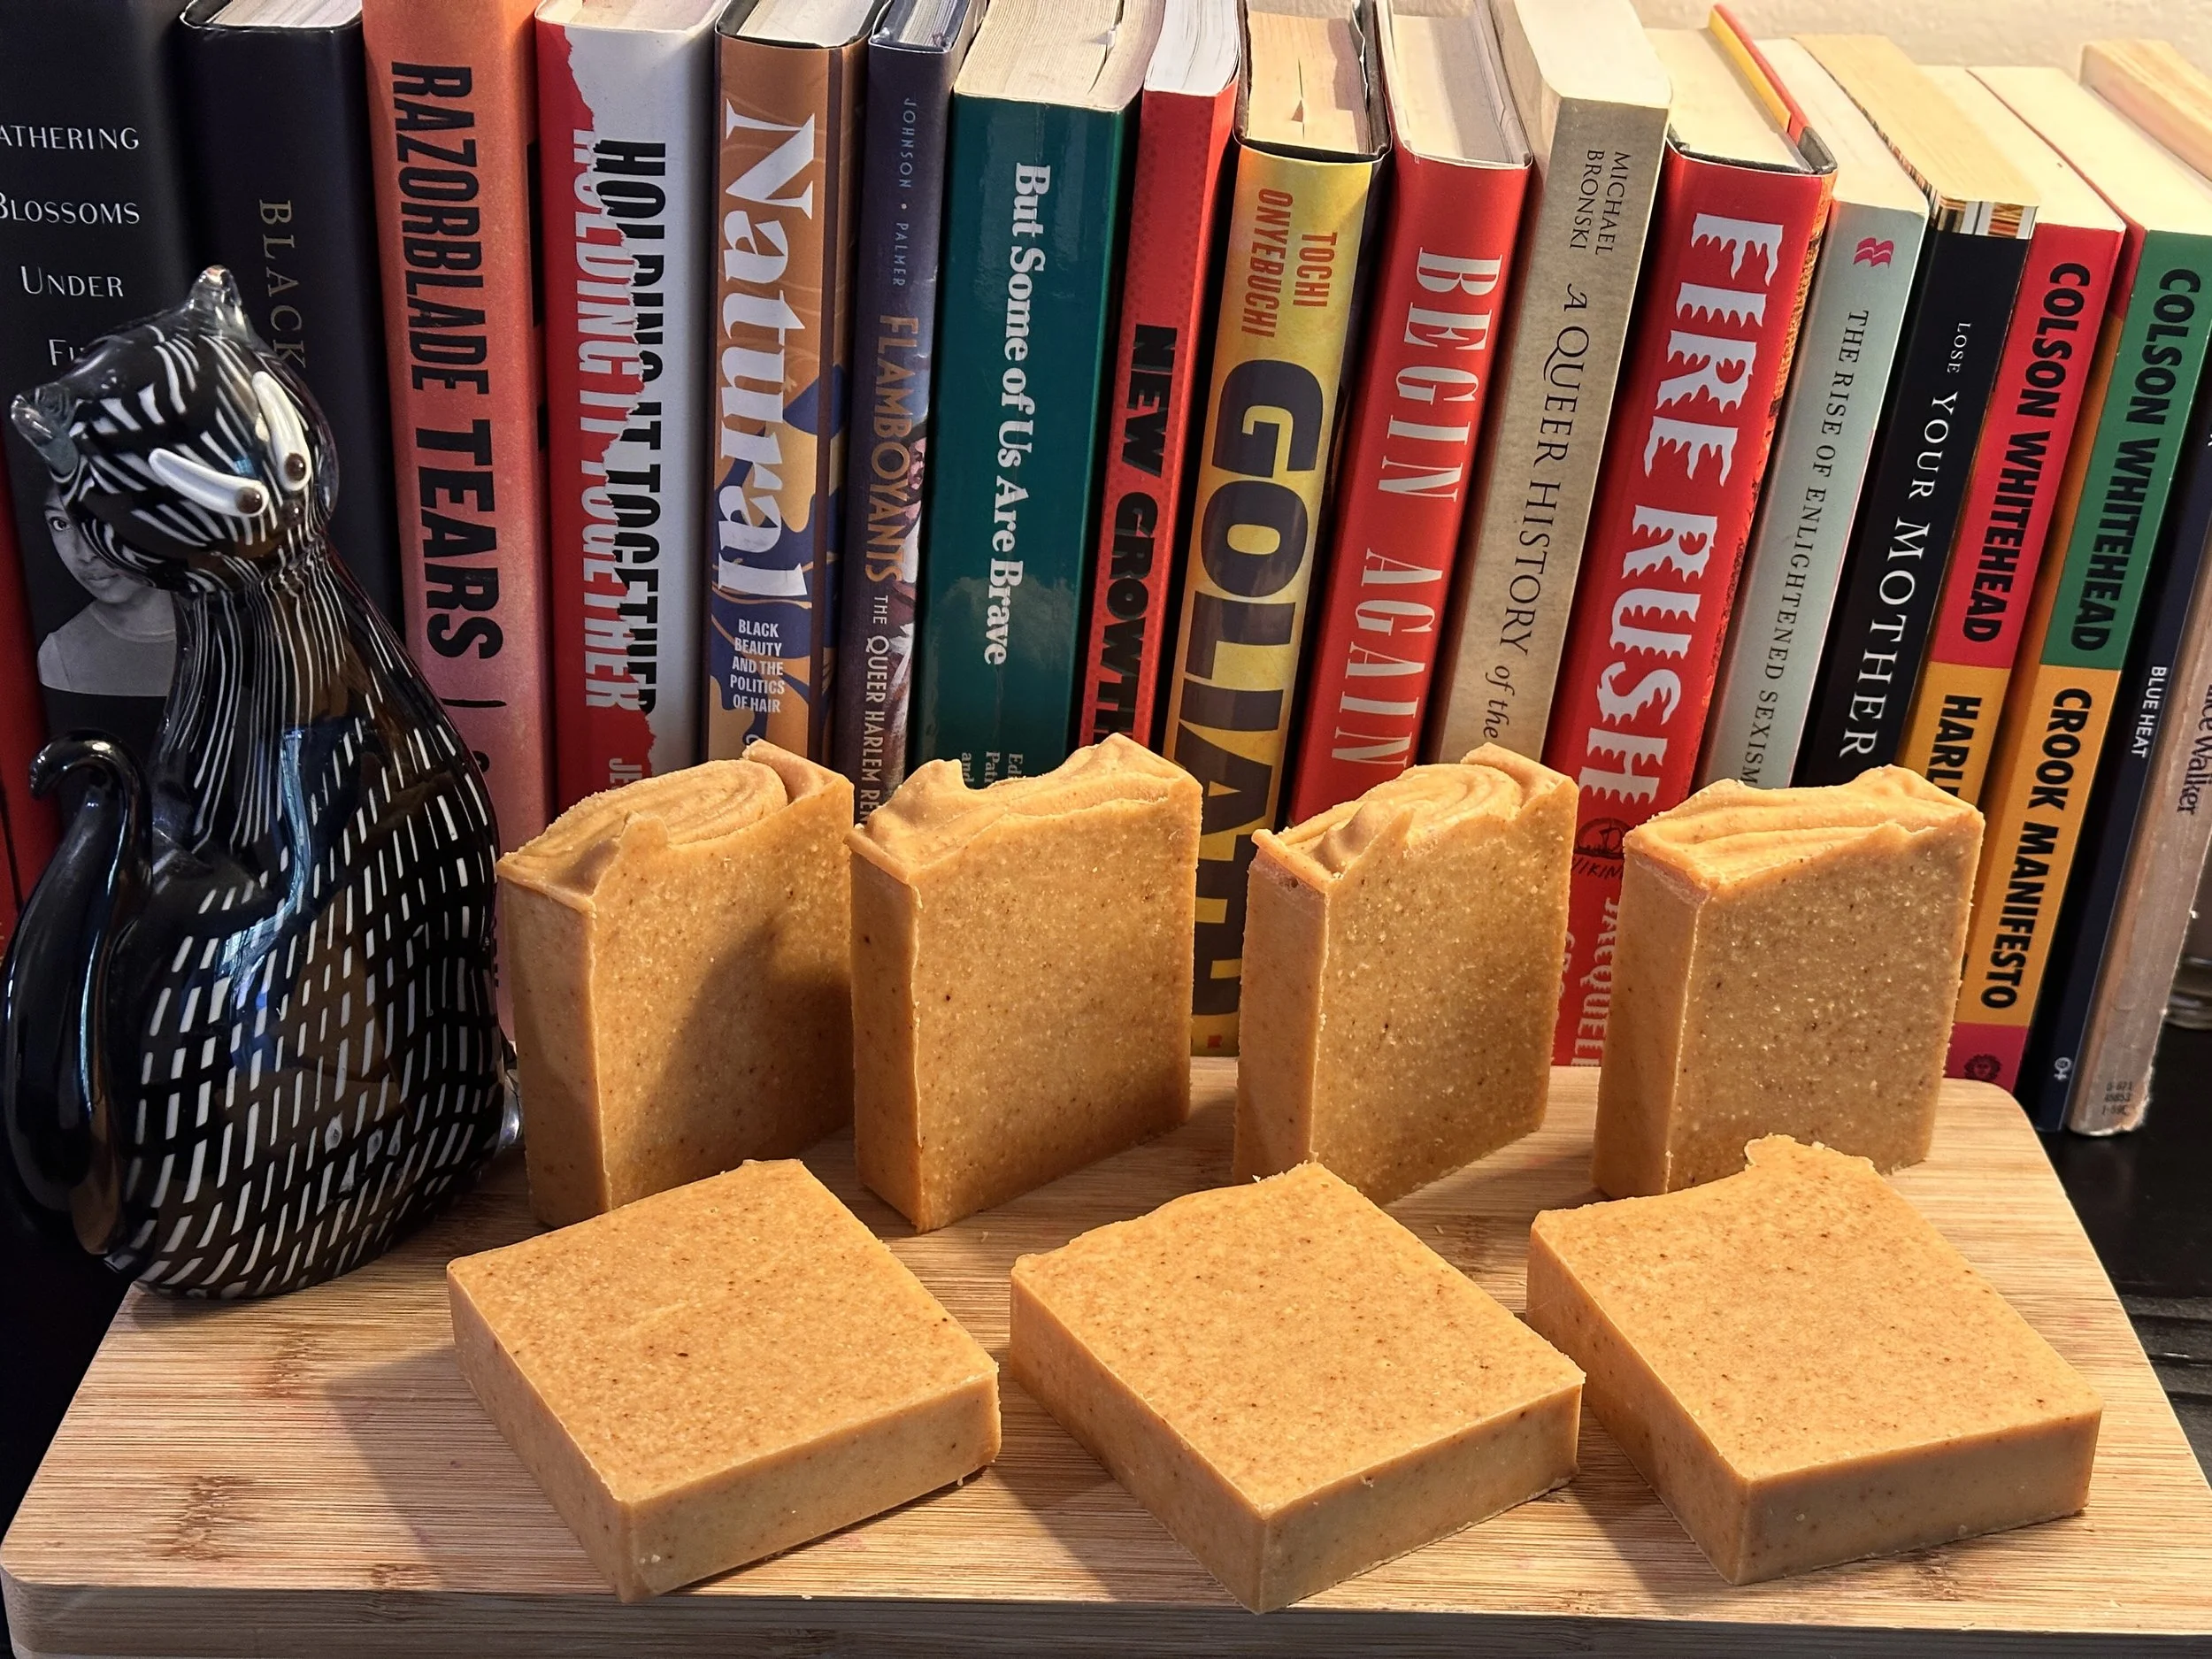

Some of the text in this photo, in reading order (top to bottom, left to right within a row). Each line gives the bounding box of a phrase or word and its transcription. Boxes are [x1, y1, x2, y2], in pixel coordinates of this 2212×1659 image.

[891, 97, 918, 287] JOHNSON PALMER
[1241, 188, 1294, 338] ONYEBUCHI
[1570, 150, 1605, 250] BRONSKI
[1594, 151, 1632, 256] MICHAEL
[20, 265, 124, 297] UNDER
[259, 200, 306, 368] BLACK
[1293, 232, 1338, 308] TOCHI
[390, 61, 503, 659] RAZORBLADE TEARS
[718, 98, 815, 596] Natural
[984, 162, 1051, 665] But Some of Us Are Brave
[1122, 324, 1178, 478] NEW
[865, 315, 919, 582] FLAMBOYANTS
[1332, 247, 1503, 768] BEGIN AGAIN
[1483, 283, 1590, 738] A QUEER HISTORY of the
[1578, 213, 1783, 804] FIRE RUSH
[1962, 262, 2091, 644] COLSON WHITEHEAD
[2070, 268, 2201, 651] COLSON WHITEHEAD
[872, 595, 889, 625] THE
[1740, 310, 1870, 786] THE RISE OF ENLIGHTENED SEXISM
[1839, 322, 1972, 759] LOSE YOUR MOTHER
[730, 674, 786, 695] POLITICS
[732, 656, 784, 676] AND THE
[733, 694, 781, 714] OF HAIR
[734, 636, 783, 657] BEAUTY
[738, 618, 780, 638] BLACK
[865, 635, 890, 703] QUEER
[862, 710, 885, 782] HARLEM
[1924, 695, 1983, 797] HARL
[2131, 666, 2167, 758] BLUE HEAT
[1981, 687, 2093, 1010] CROOK MANIFESTO
